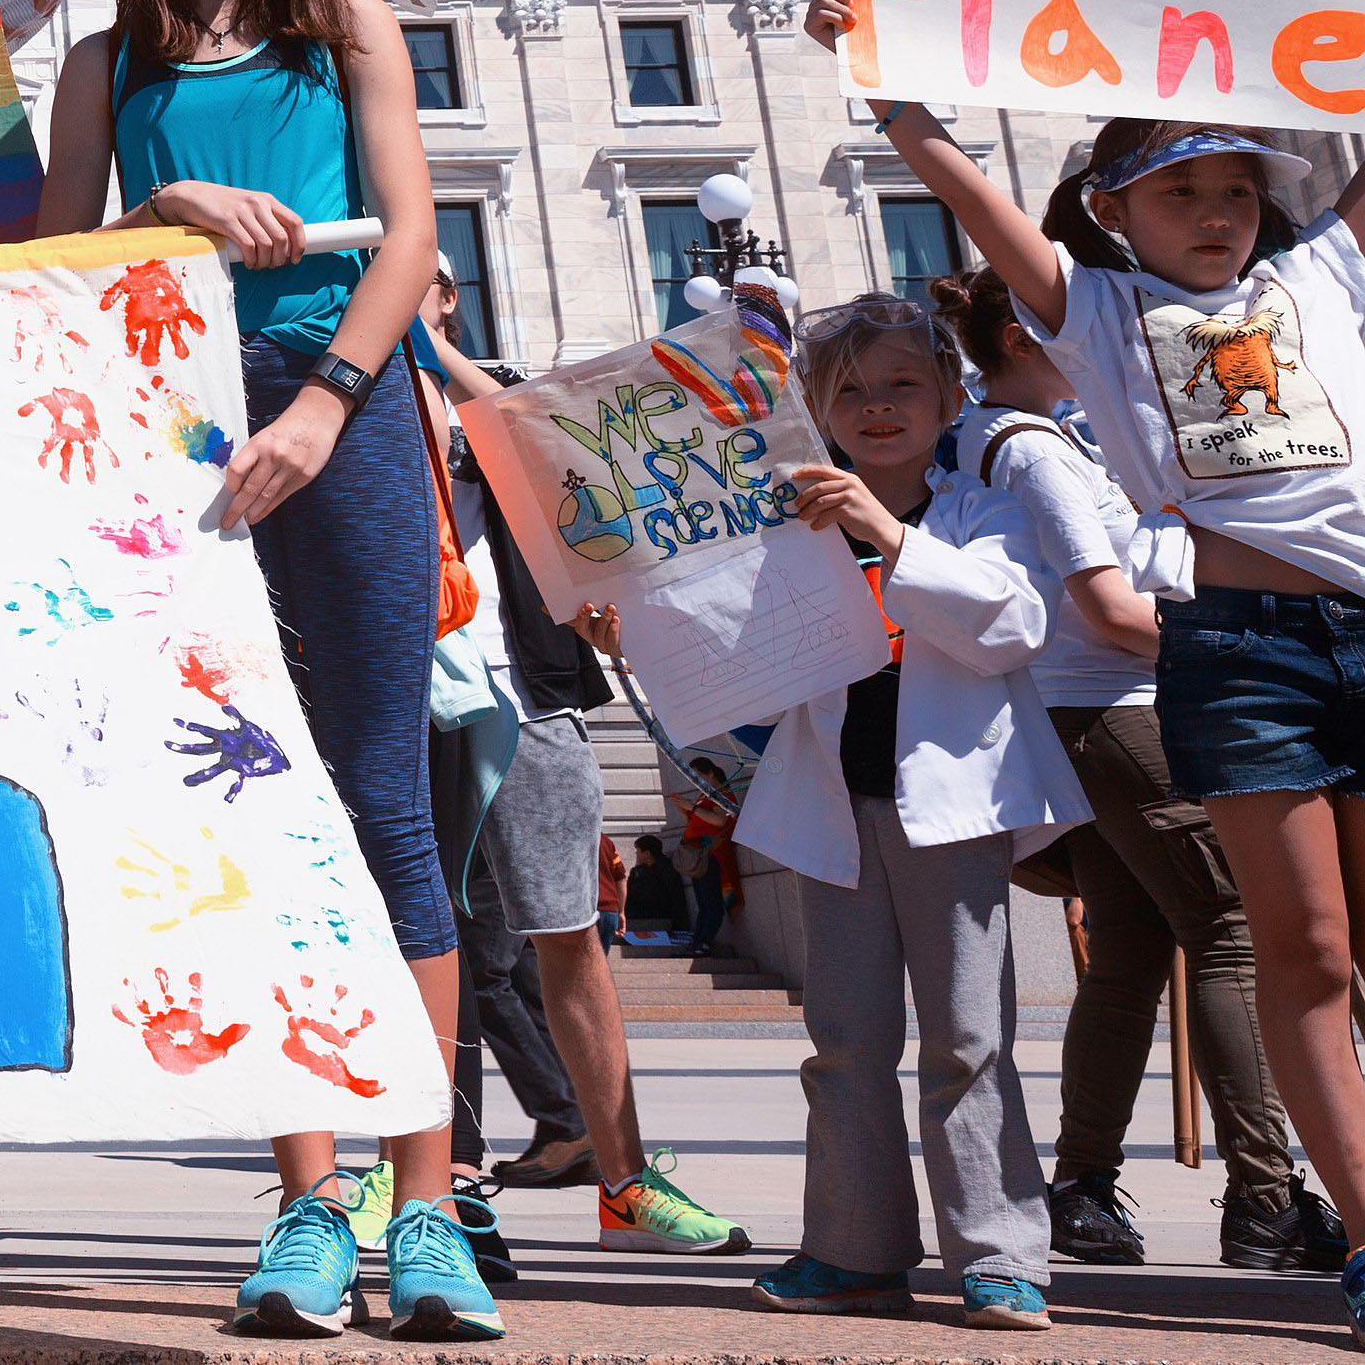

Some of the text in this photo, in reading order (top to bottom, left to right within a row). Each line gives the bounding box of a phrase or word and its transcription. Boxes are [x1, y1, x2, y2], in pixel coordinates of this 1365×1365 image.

[1186, 420, 1259, 453] I speak
[1228, 439, 1344, 466] for the trees.
